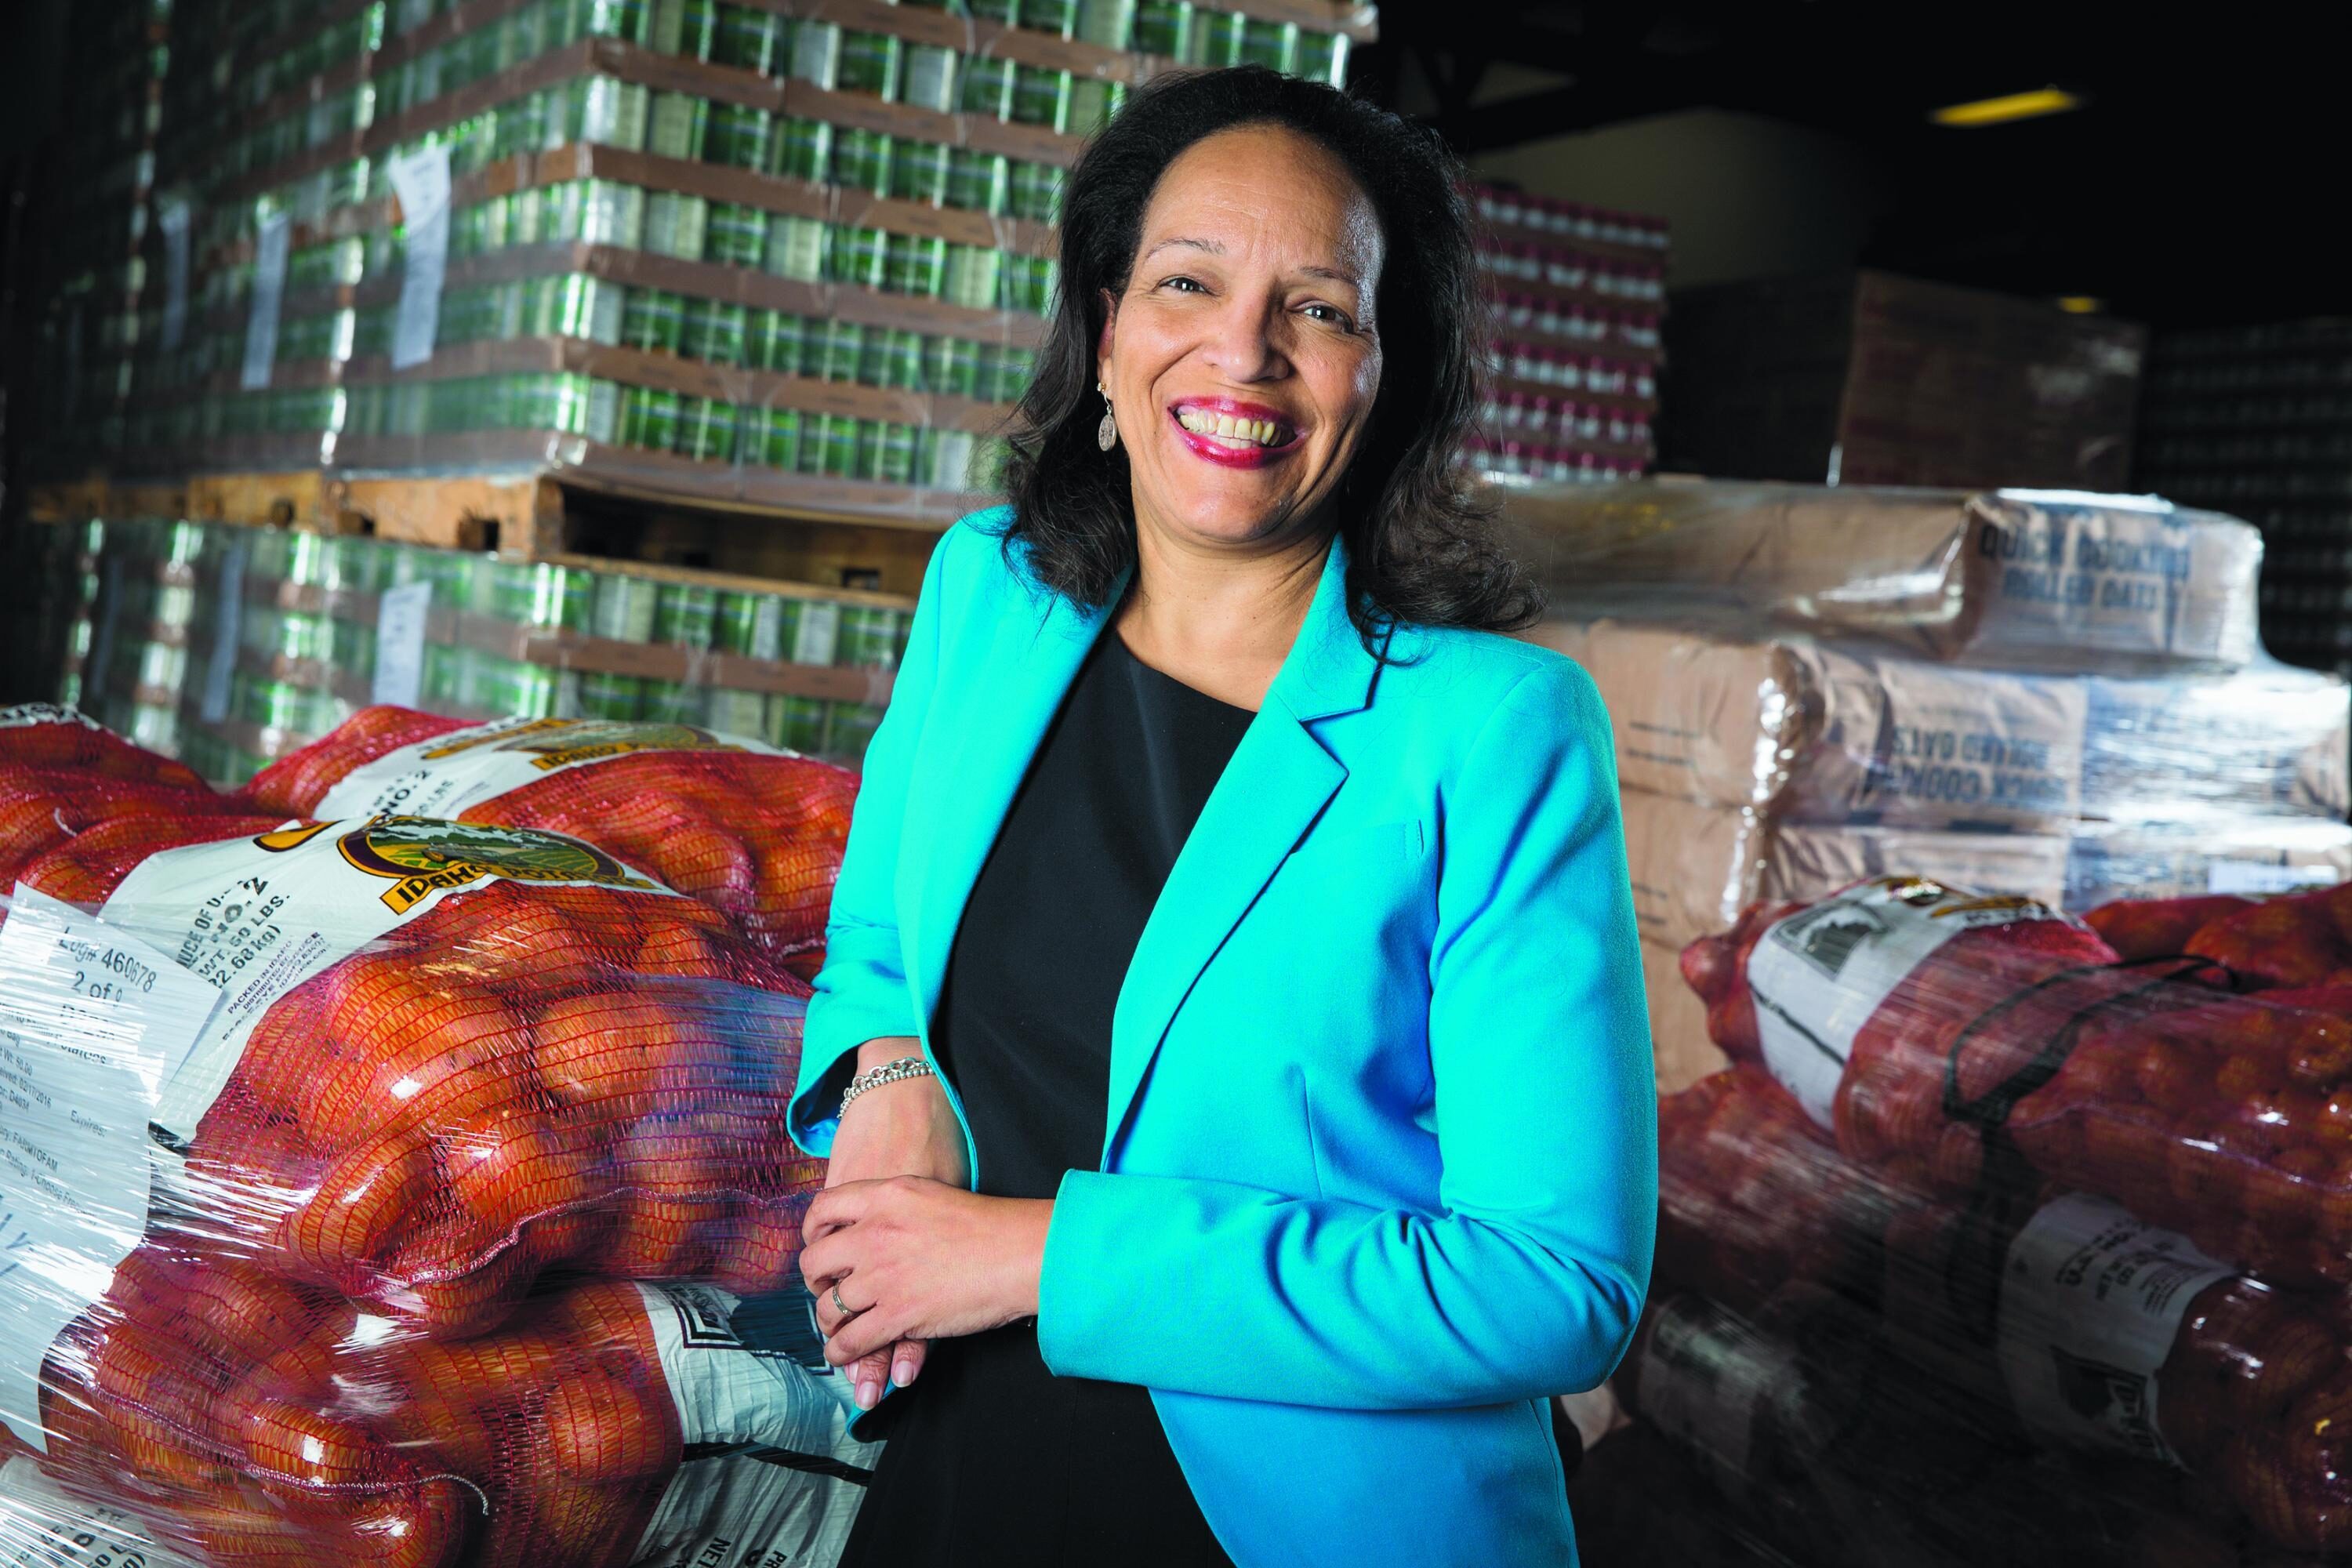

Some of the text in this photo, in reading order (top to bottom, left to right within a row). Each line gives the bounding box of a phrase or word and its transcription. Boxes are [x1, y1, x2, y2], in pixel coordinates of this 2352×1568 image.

[242, 877, 269, 896] 2
[194, 909, 213, 930] OF
[198, 949, 231, 976] WT.
[250, 894, 291, 927] LBS.
[101, 948, 157, 993] 460678
[71, 971, 85, 994] 2
[89, 982, 113, 1000] of
[227, 978, 261, 1014] PACKED
[71, 1109, 107, 1138] Expires:
